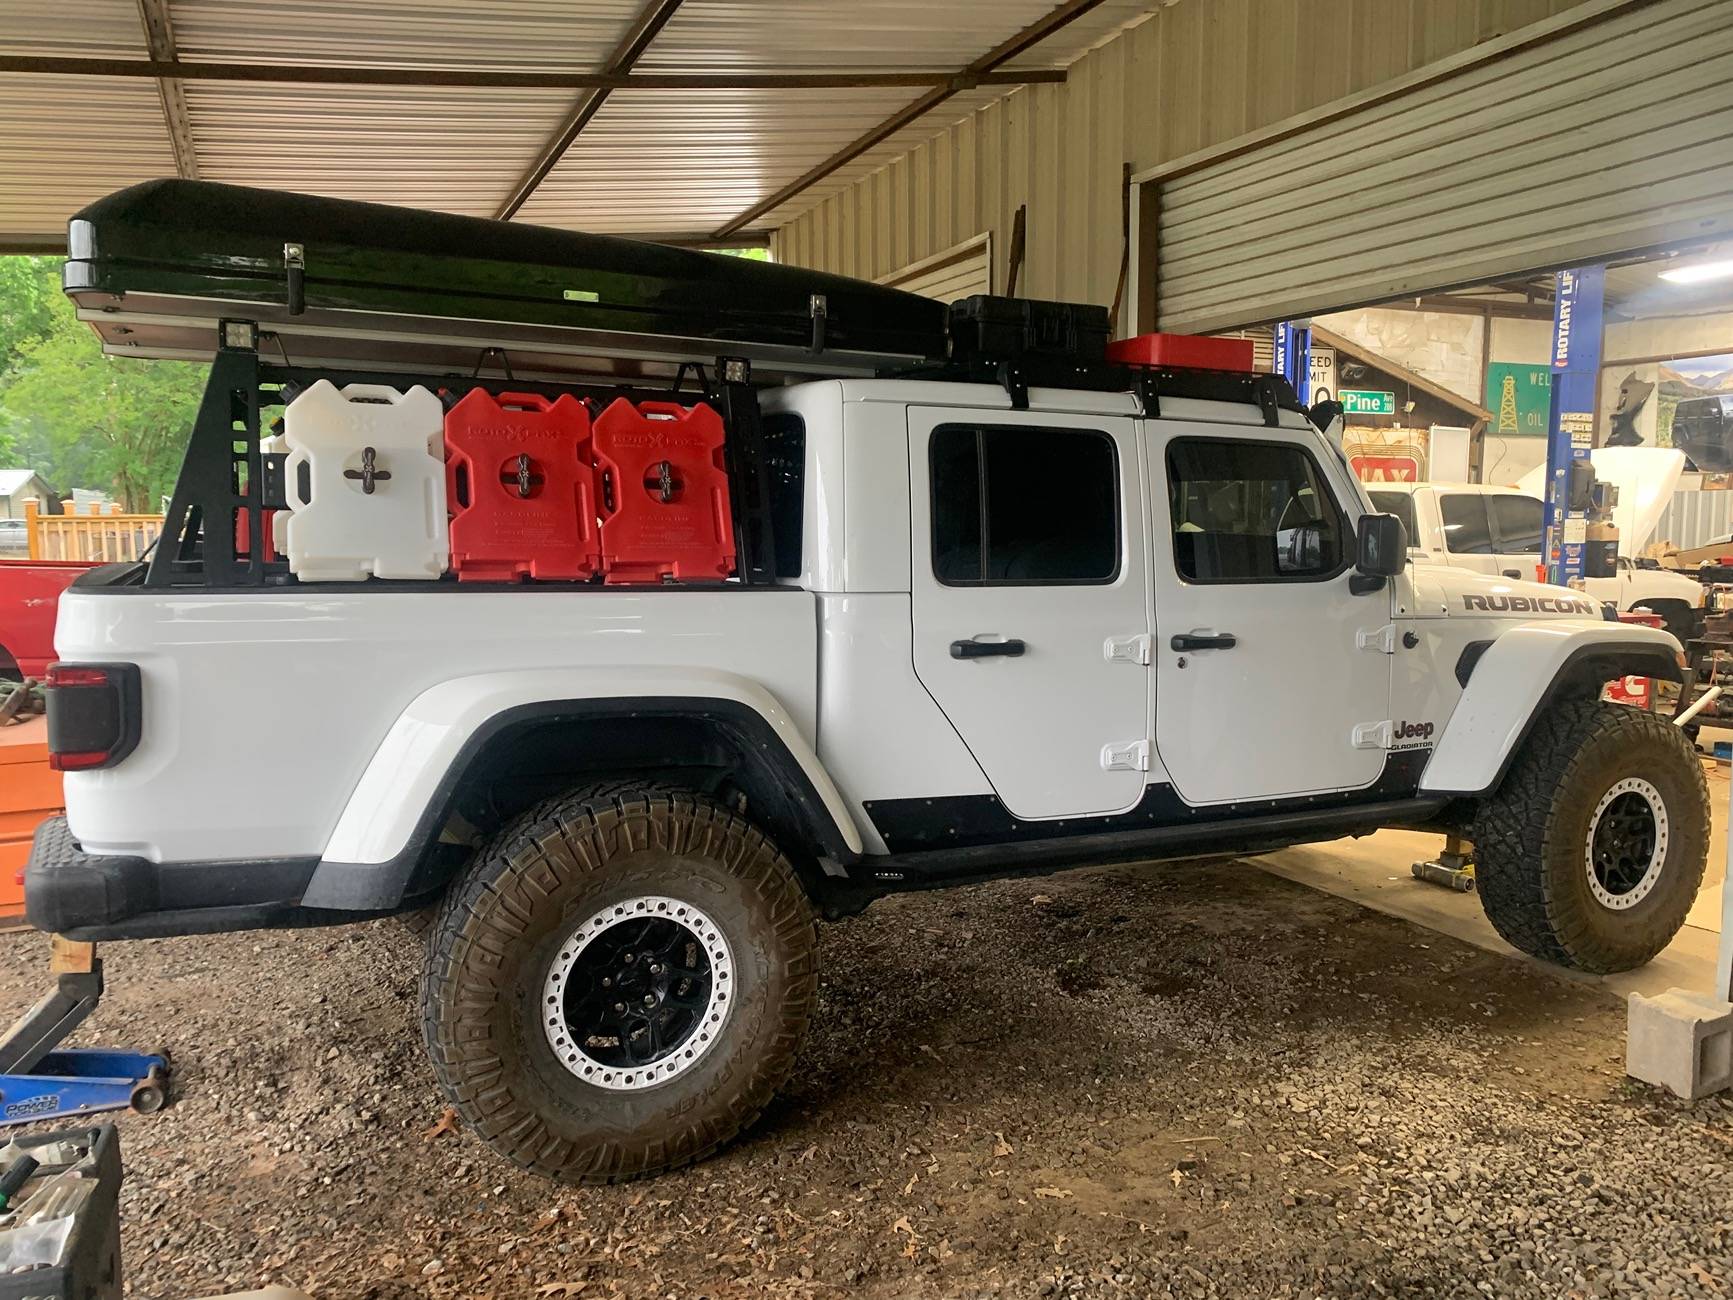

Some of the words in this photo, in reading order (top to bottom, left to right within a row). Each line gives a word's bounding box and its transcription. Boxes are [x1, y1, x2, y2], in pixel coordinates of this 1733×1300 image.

[1562, 270, 1574, 295] LIF
[1557, 300, 1571, 359] ROTARY
[1310, 356, 1332, 368] EED
[1310, 371, 1327, 383] MIT
[1530, 372, 1550, 386] WEL
[1346, 394, 1380, 410] Pine
[1527, 412, 1543, 426] OIL
[1462, 594, 1594, 615] RUBICON
[1394, 720, 1434, 739] Jeep
[1391, 741, 1433, 750] GLADIATOR
